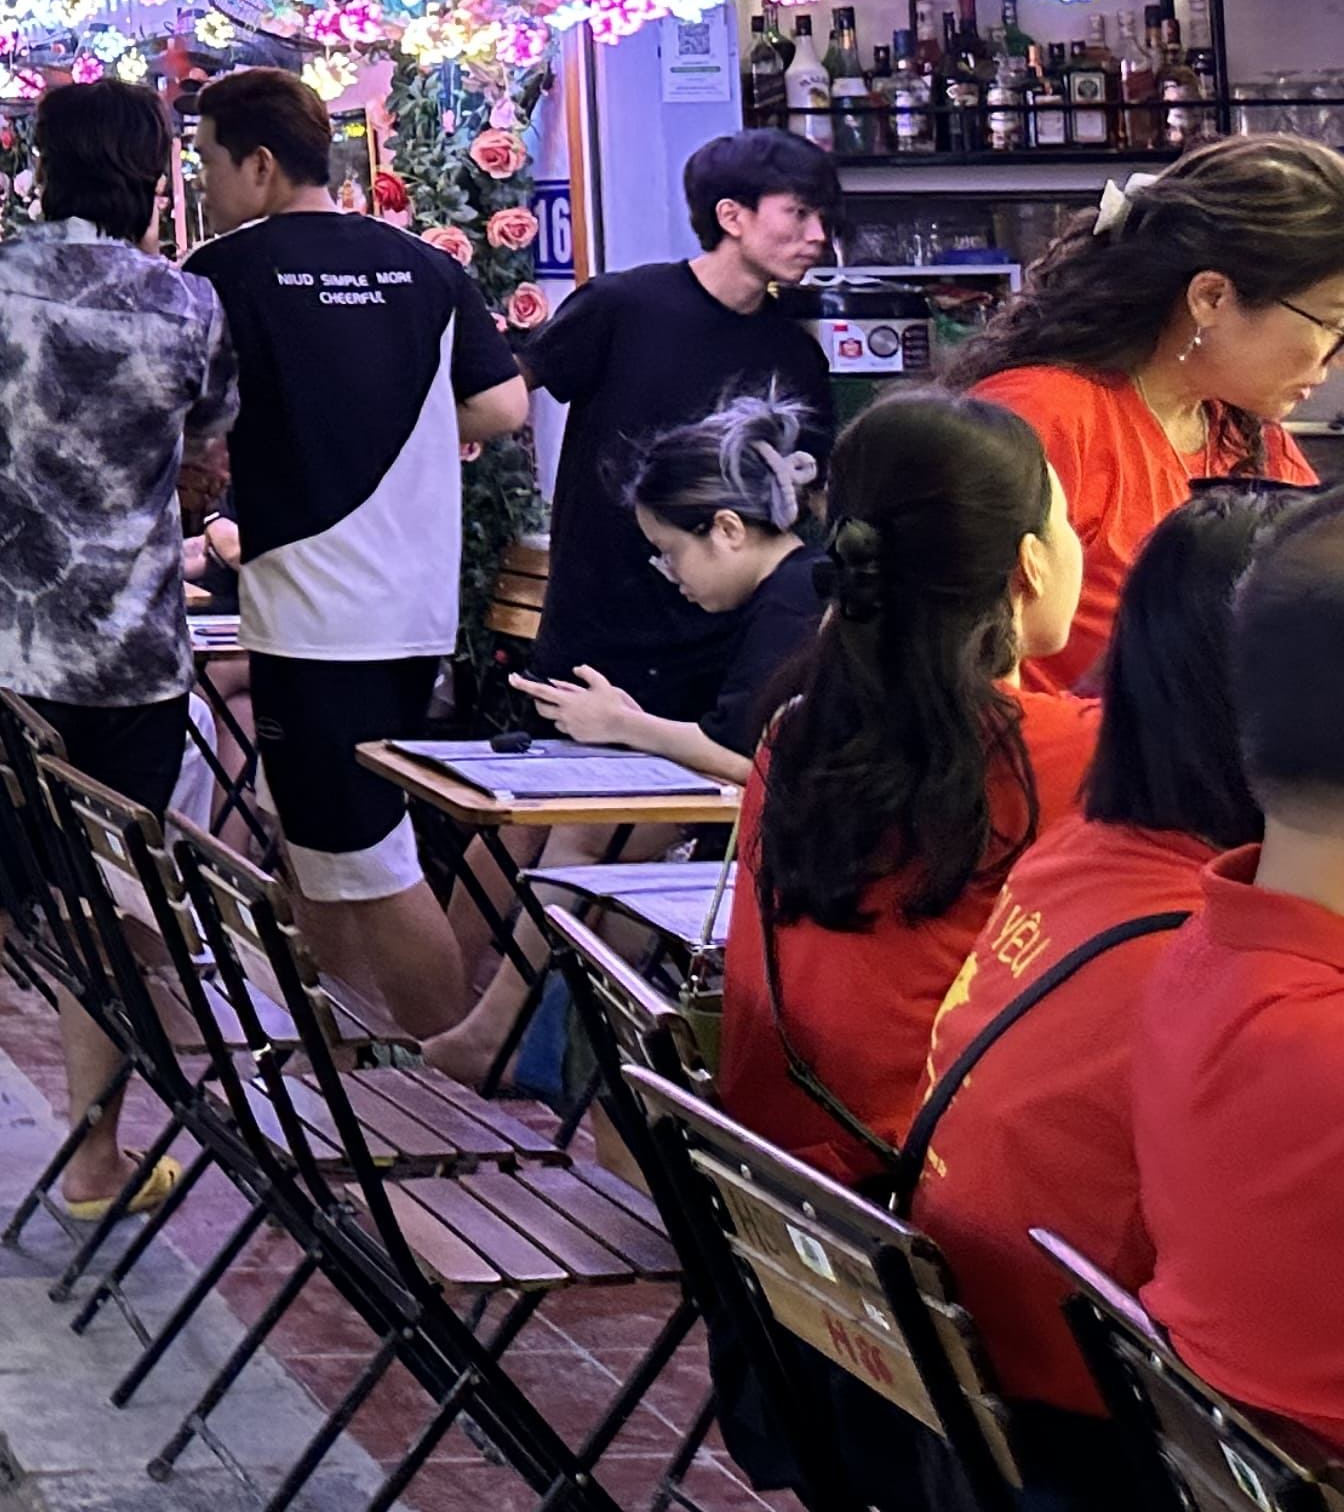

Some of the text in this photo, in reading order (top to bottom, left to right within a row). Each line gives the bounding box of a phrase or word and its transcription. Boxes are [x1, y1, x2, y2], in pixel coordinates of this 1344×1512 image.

[534, 196, 572, 264] 16
[319, 290, 386, 305] CHEERFUL
[992, 904, 1052, 979] YÊU
